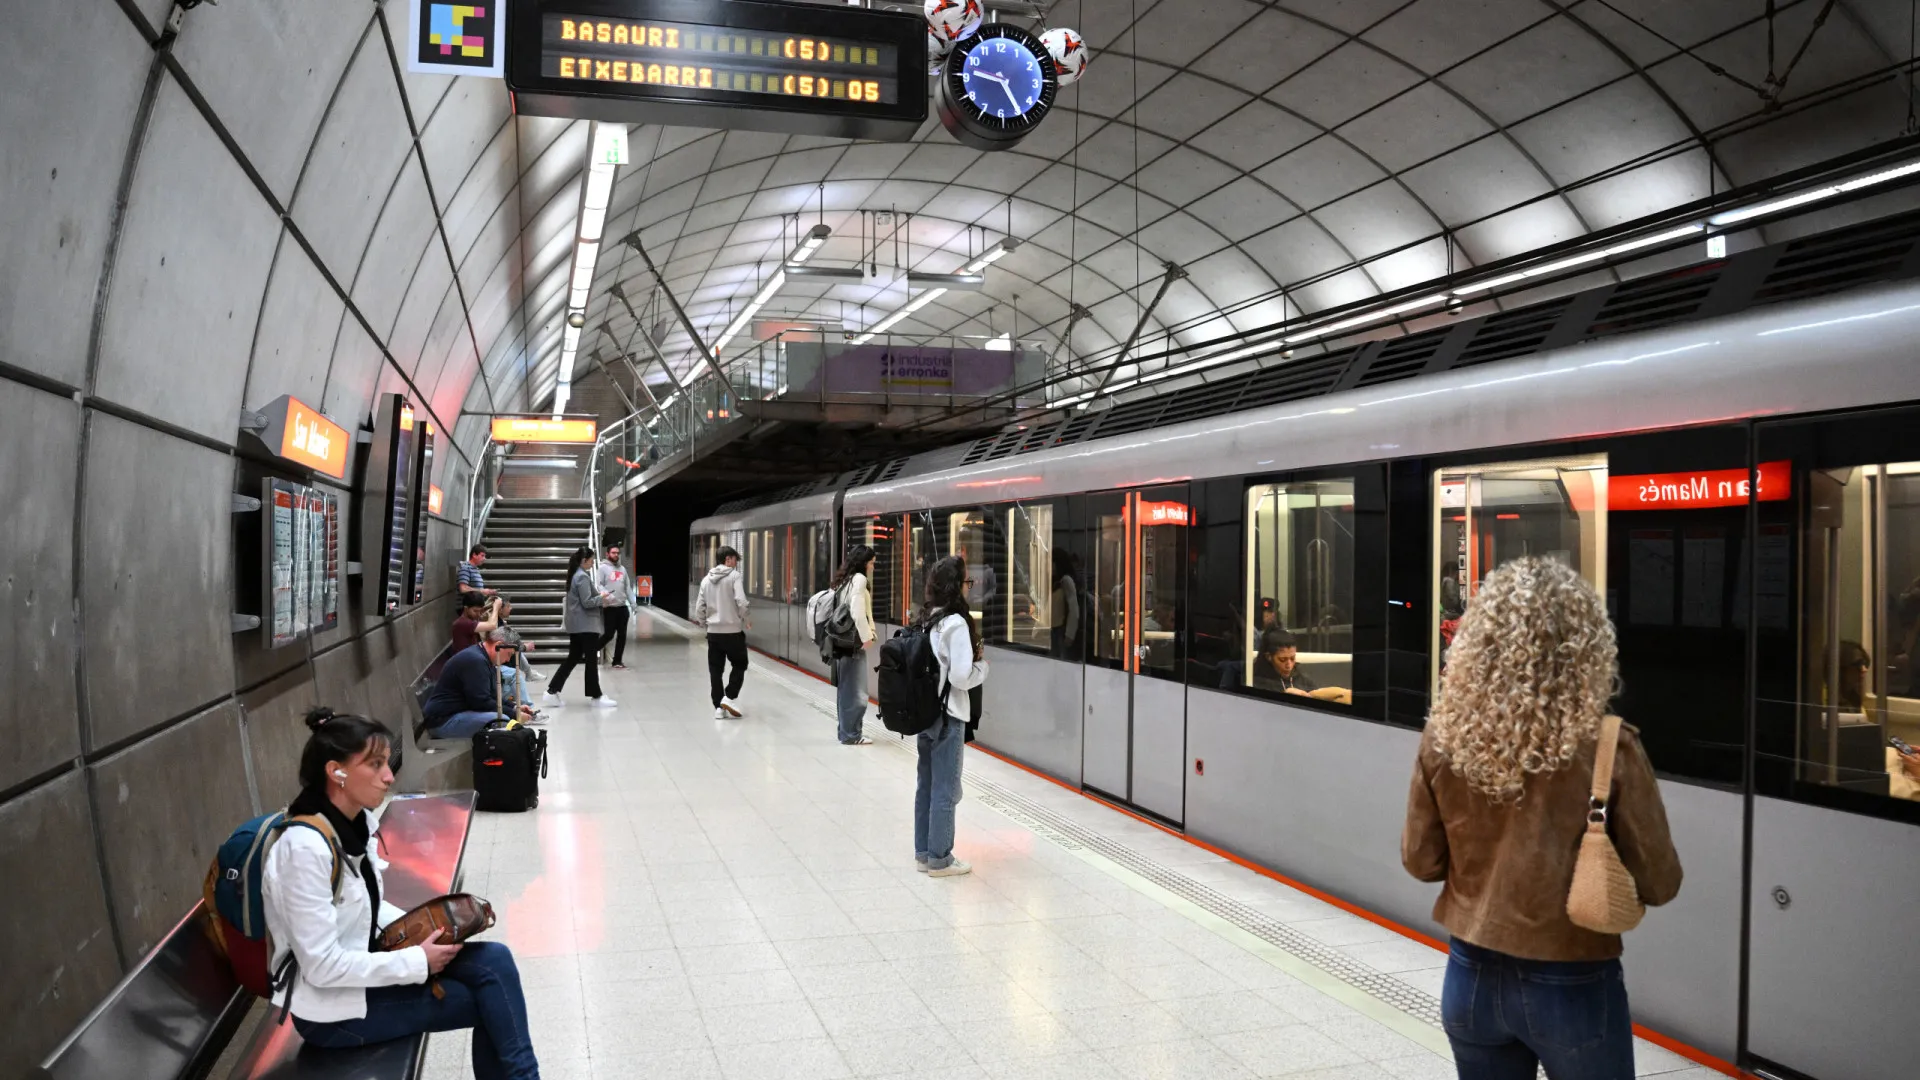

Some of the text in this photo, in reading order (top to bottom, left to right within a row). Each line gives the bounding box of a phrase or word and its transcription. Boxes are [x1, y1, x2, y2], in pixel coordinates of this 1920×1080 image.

[561, 20, 830, 61] BASAURI (5)
[980, 46, 989, 56] 11
[996, 43, 1006, 53] 12
[1014, 48, 1019, 58] 1
[969, 56, 980, 66] 10
[1026, 61, 1033, 71] 2
[560, 57, 879, 102] ETXEBARRI (5) 05
[962, 74, 970, 82] 9
[1032, 79, 1039, 89] 3
[969, 91, 976, 101] 8
[1025, 96, 1033, 105] 4
[981, 103, 988, 113] 7
[997, 109, 1004, 118] 6
